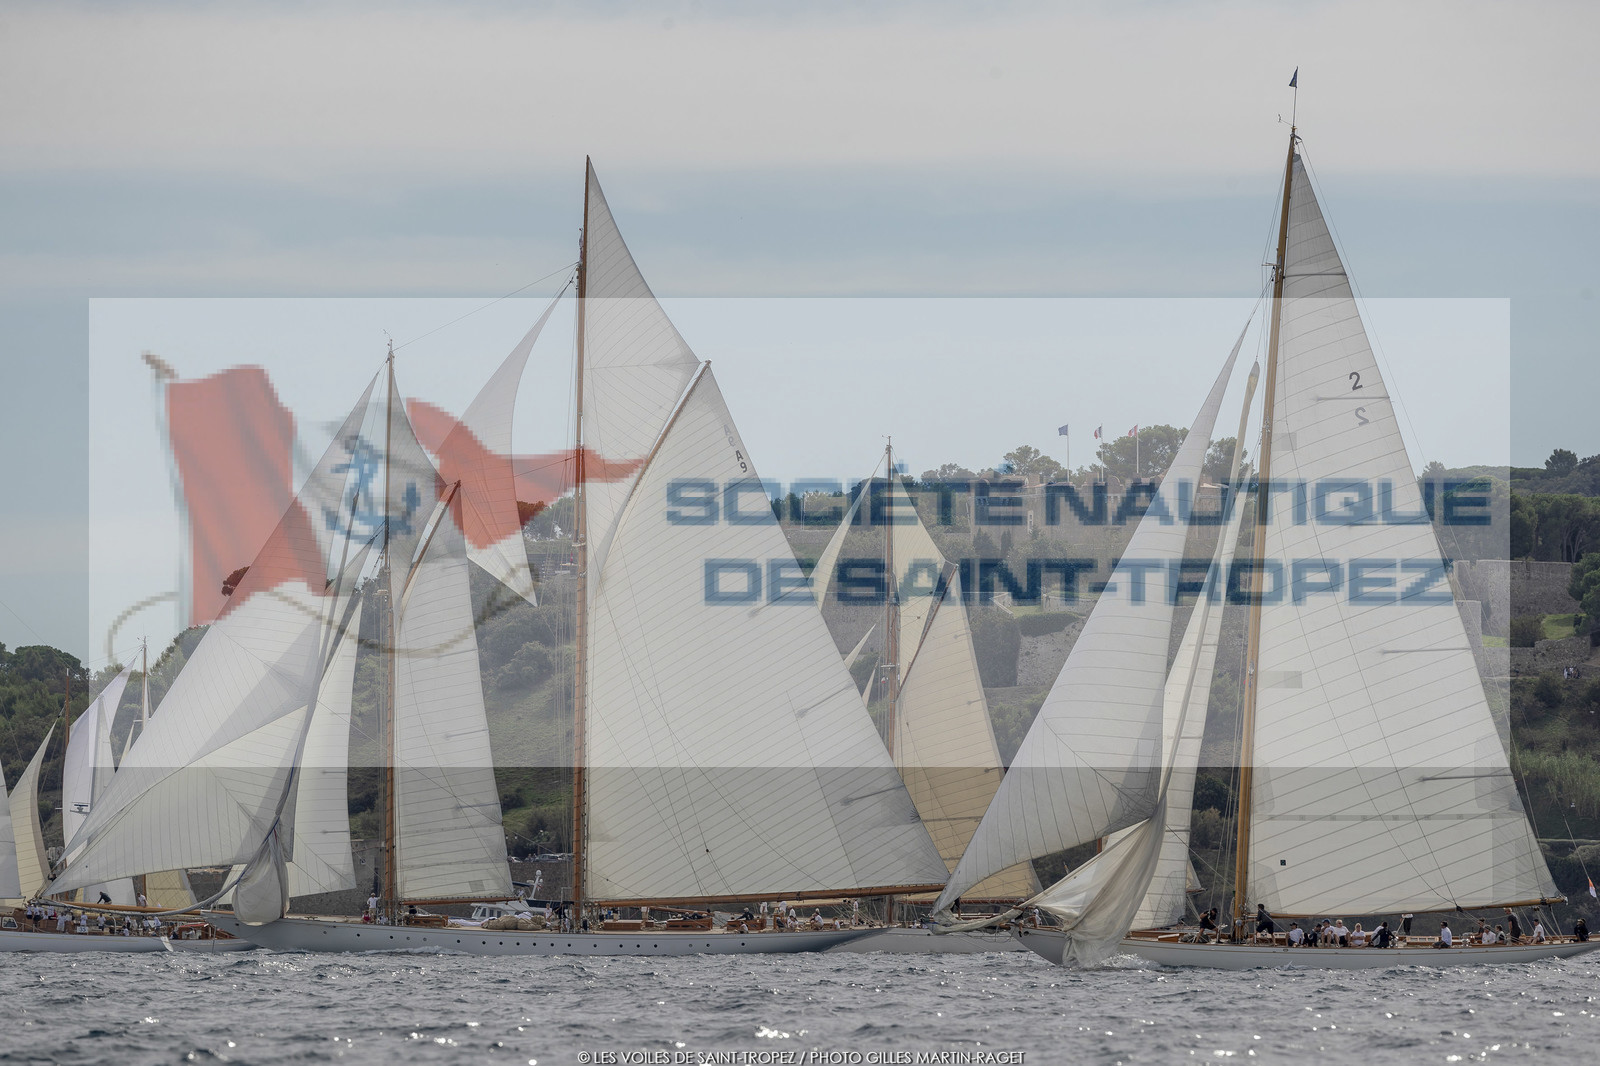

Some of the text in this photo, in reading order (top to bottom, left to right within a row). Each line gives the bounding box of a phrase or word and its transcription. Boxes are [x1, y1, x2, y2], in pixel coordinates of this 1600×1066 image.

[1349, 371, 1363, 391] 2
[735, 449, 744, 462] A
[739, 461, 748, 473] 9
